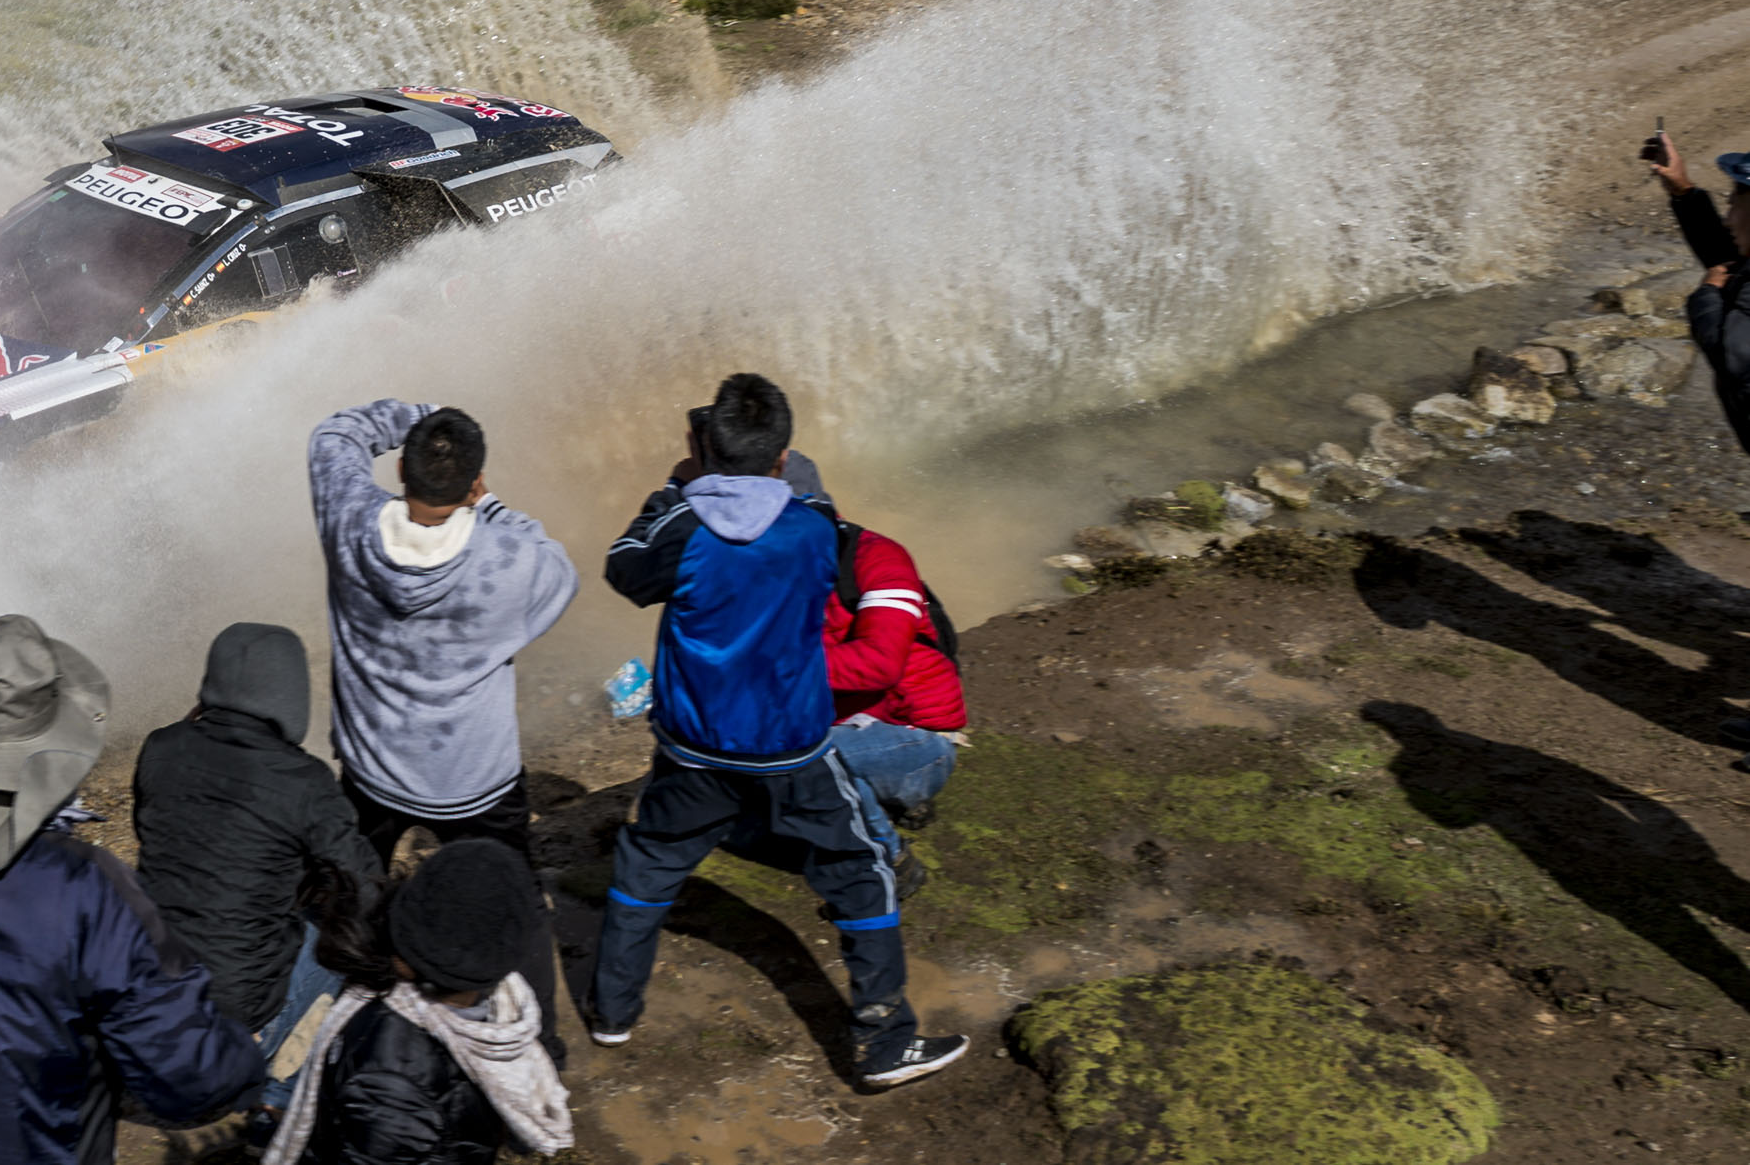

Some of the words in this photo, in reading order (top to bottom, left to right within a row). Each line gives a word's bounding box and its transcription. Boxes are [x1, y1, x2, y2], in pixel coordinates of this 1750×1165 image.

[205, 120, 277, 140] 303
[243, 104, 365, 147] TOTAL
[486, 174, 597, 223] PEUGEOT
